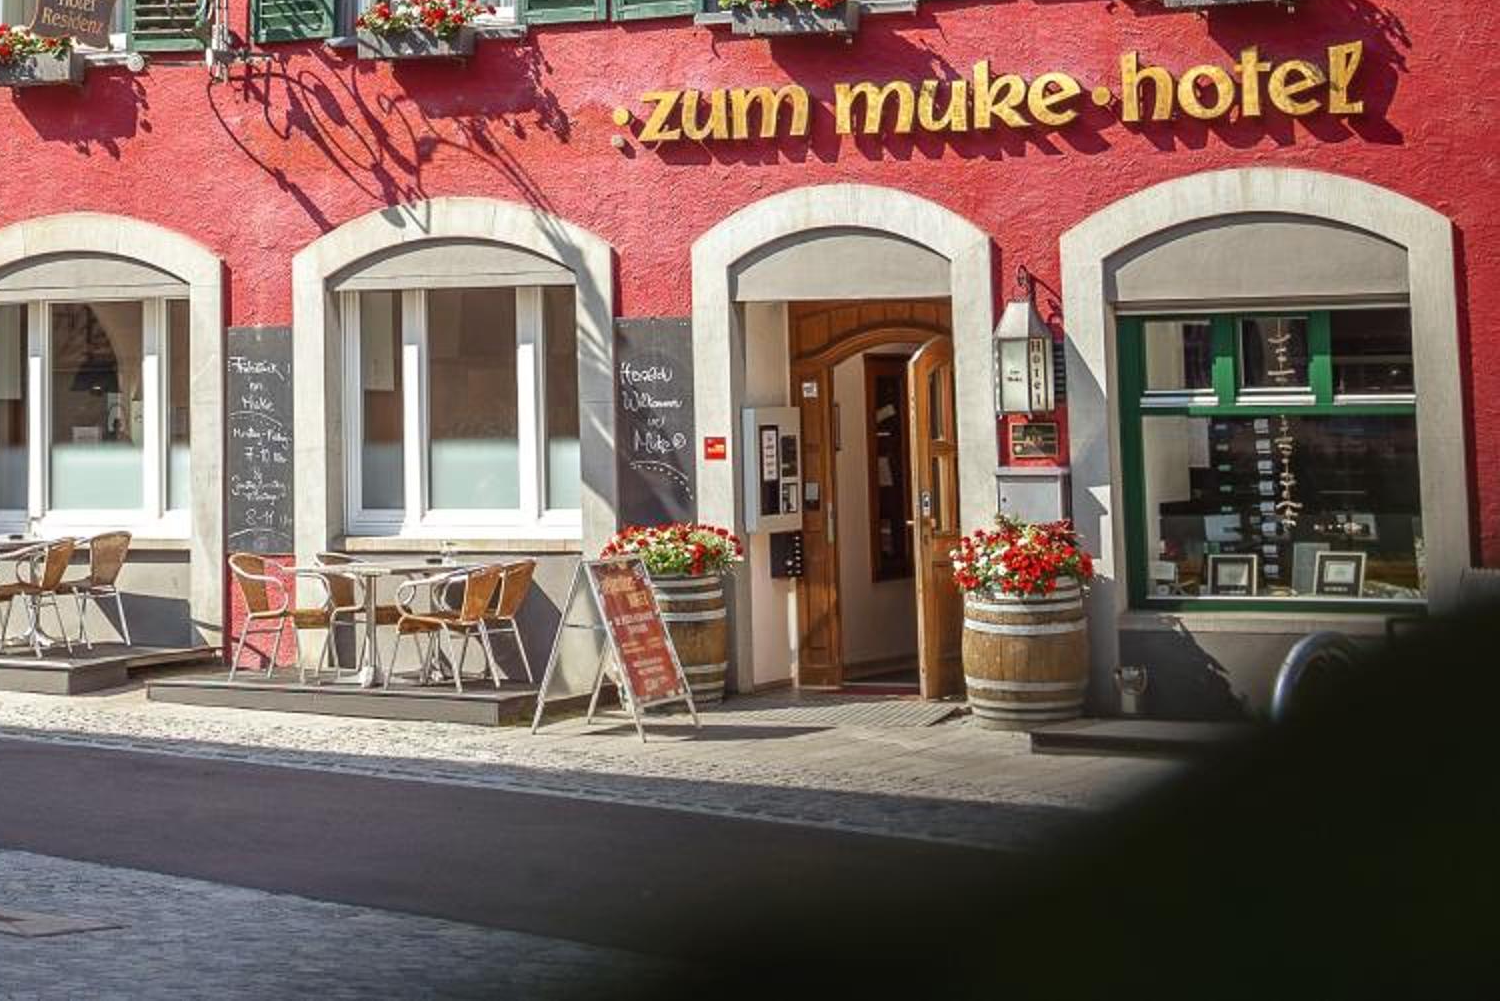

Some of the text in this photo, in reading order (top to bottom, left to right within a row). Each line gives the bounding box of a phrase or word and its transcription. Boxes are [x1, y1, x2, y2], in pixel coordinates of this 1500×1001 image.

[639, 40, 1364, 142] zum muke hotel
[1031, 340, 1042, 406] Hotel
